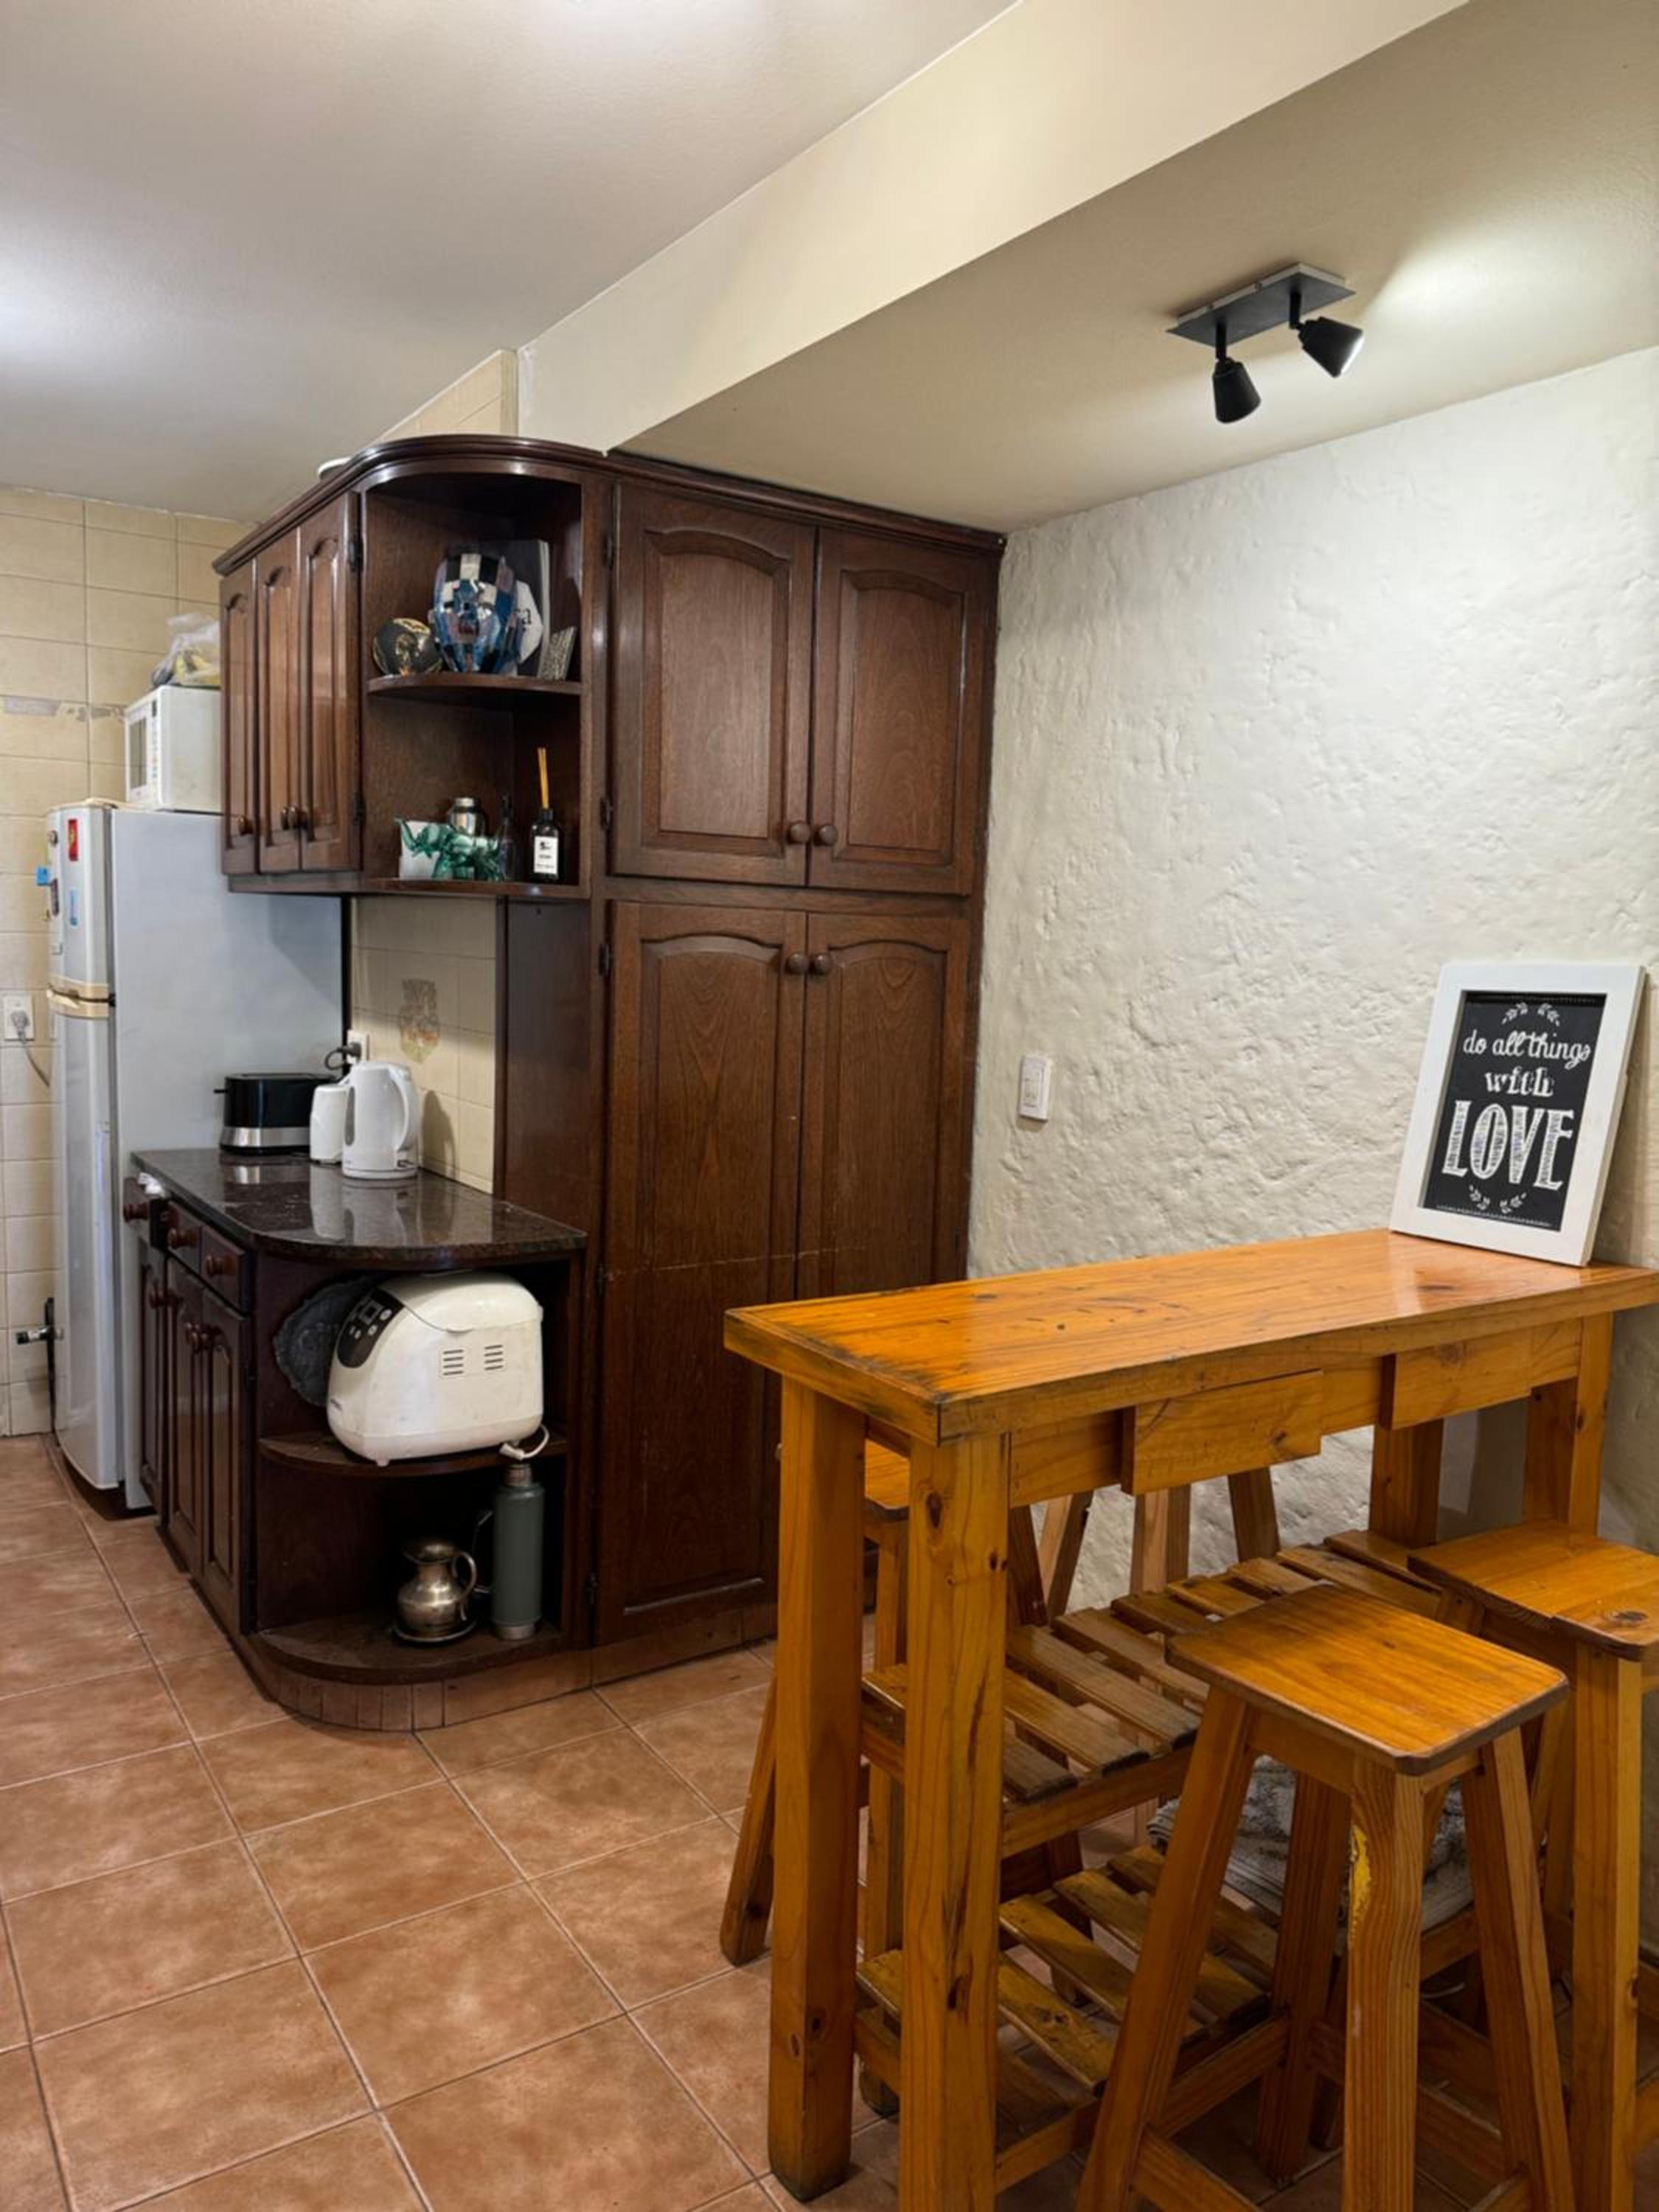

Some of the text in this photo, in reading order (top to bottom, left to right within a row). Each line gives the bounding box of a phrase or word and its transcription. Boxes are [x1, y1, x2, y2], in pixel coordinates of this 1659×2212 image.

[1463, 1029, 1591, 1070] do all things
[1484, 1065, 1555, 1097] with
[1441, 1099, 1574, 1190] LOVE
